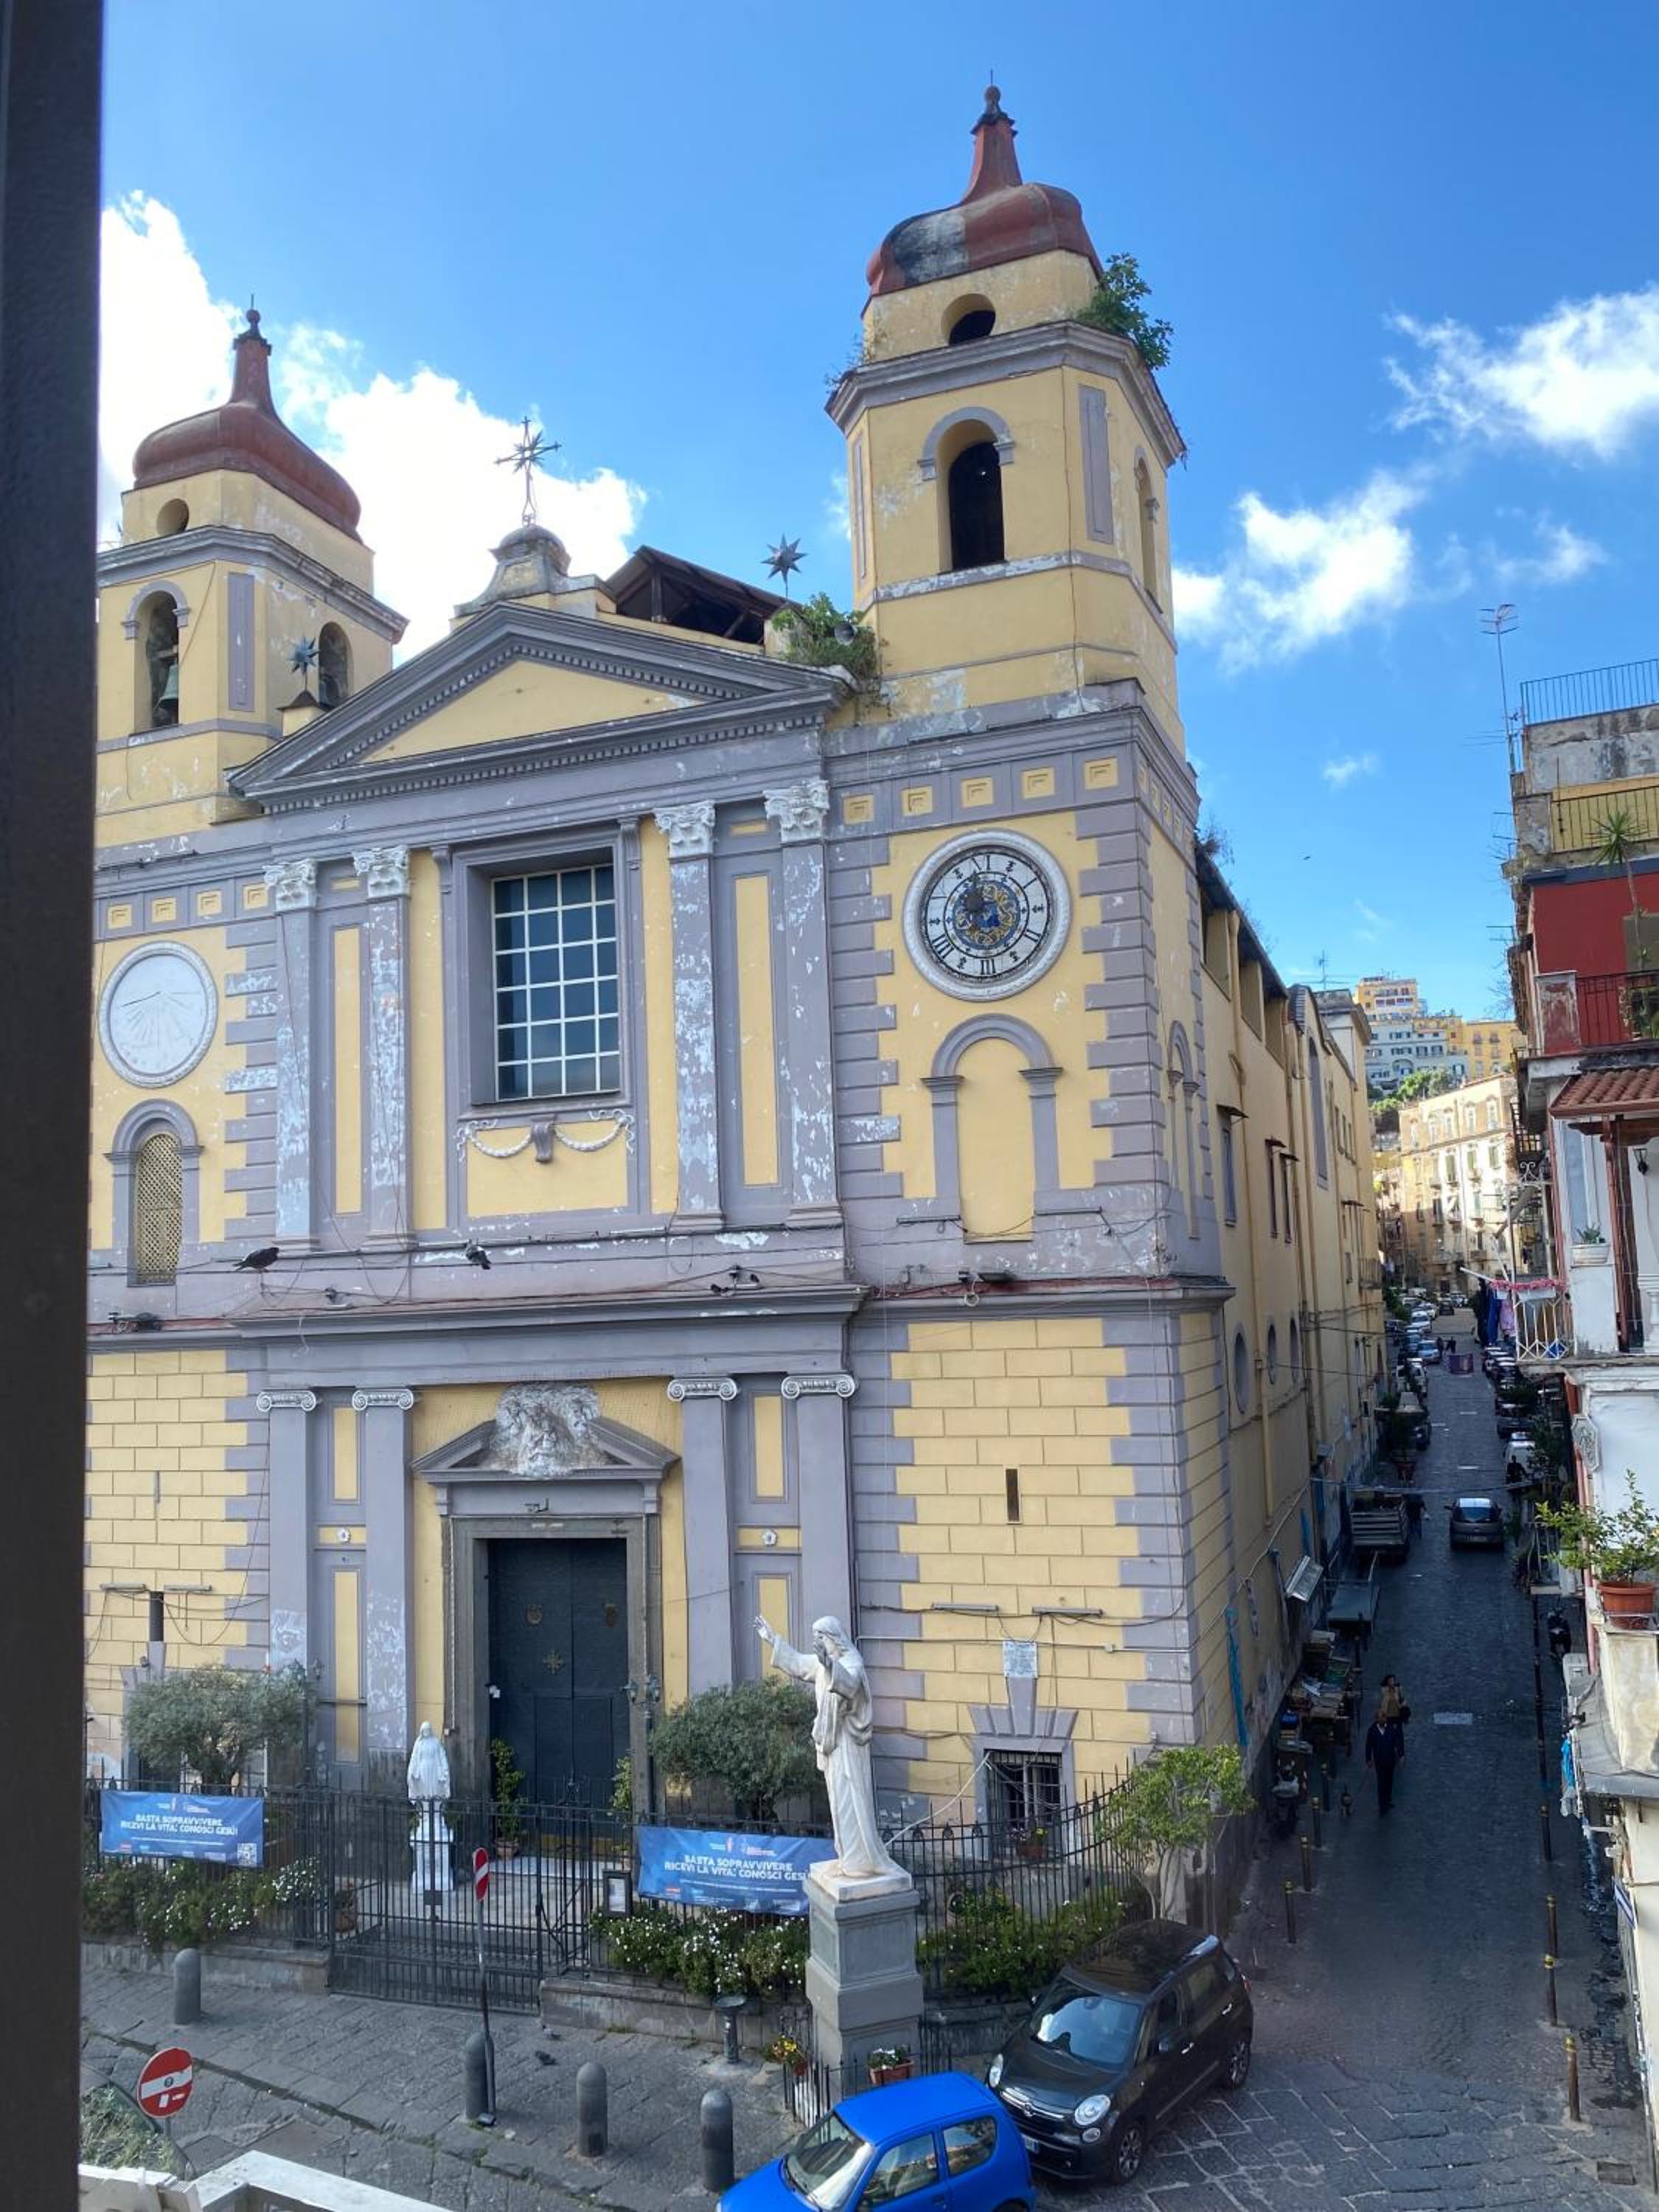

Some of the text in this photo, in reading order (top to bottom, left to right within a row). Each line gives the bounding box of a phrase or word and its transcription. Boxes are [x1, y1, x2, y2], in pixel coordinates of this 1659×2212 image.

[146, 1823, 156, 1831] LA
[664, 1862, 696, 1873] RICEVI
[698, 1864, 709, 1874] LA
[739, 1868, 782, 1879] CONOSCI
[684, 1854, 793, 1871] BASTA SOPRAVVIVERE
